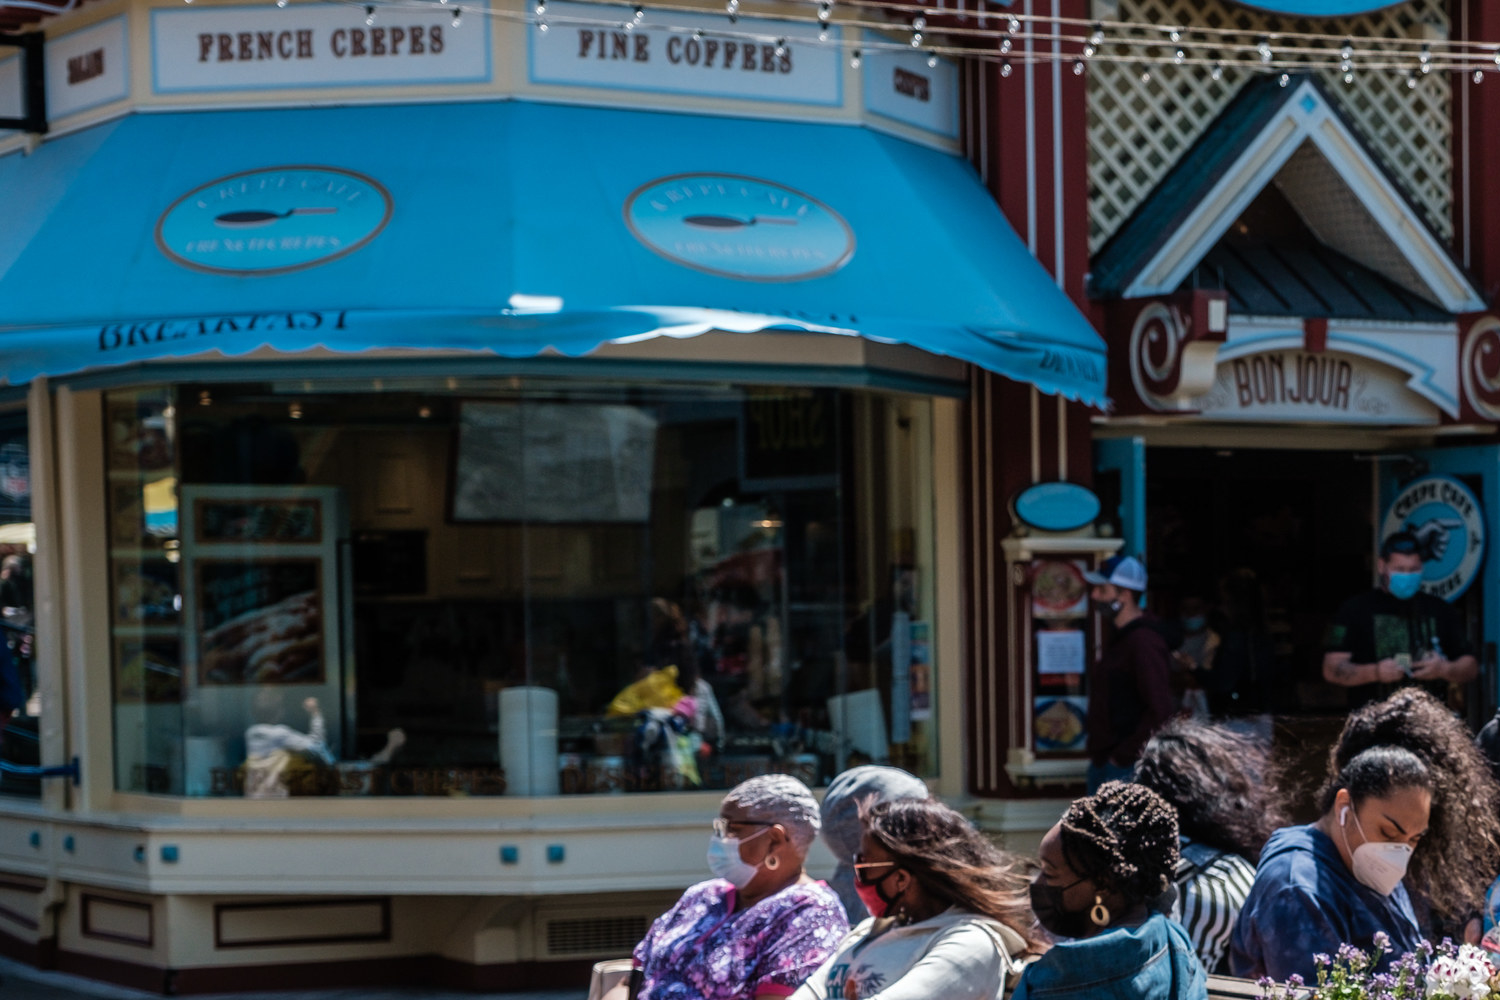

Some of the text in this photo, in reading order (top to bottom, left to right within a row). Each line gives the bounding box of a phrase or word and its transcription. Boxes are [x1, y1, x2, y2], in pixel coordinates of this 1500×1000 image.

[198, 25, 445, 63] FRENCH CREPES
[578, 29, 793, 74] FINE COFFEES
[1232, 353, 1355, 409] BONJOUR
